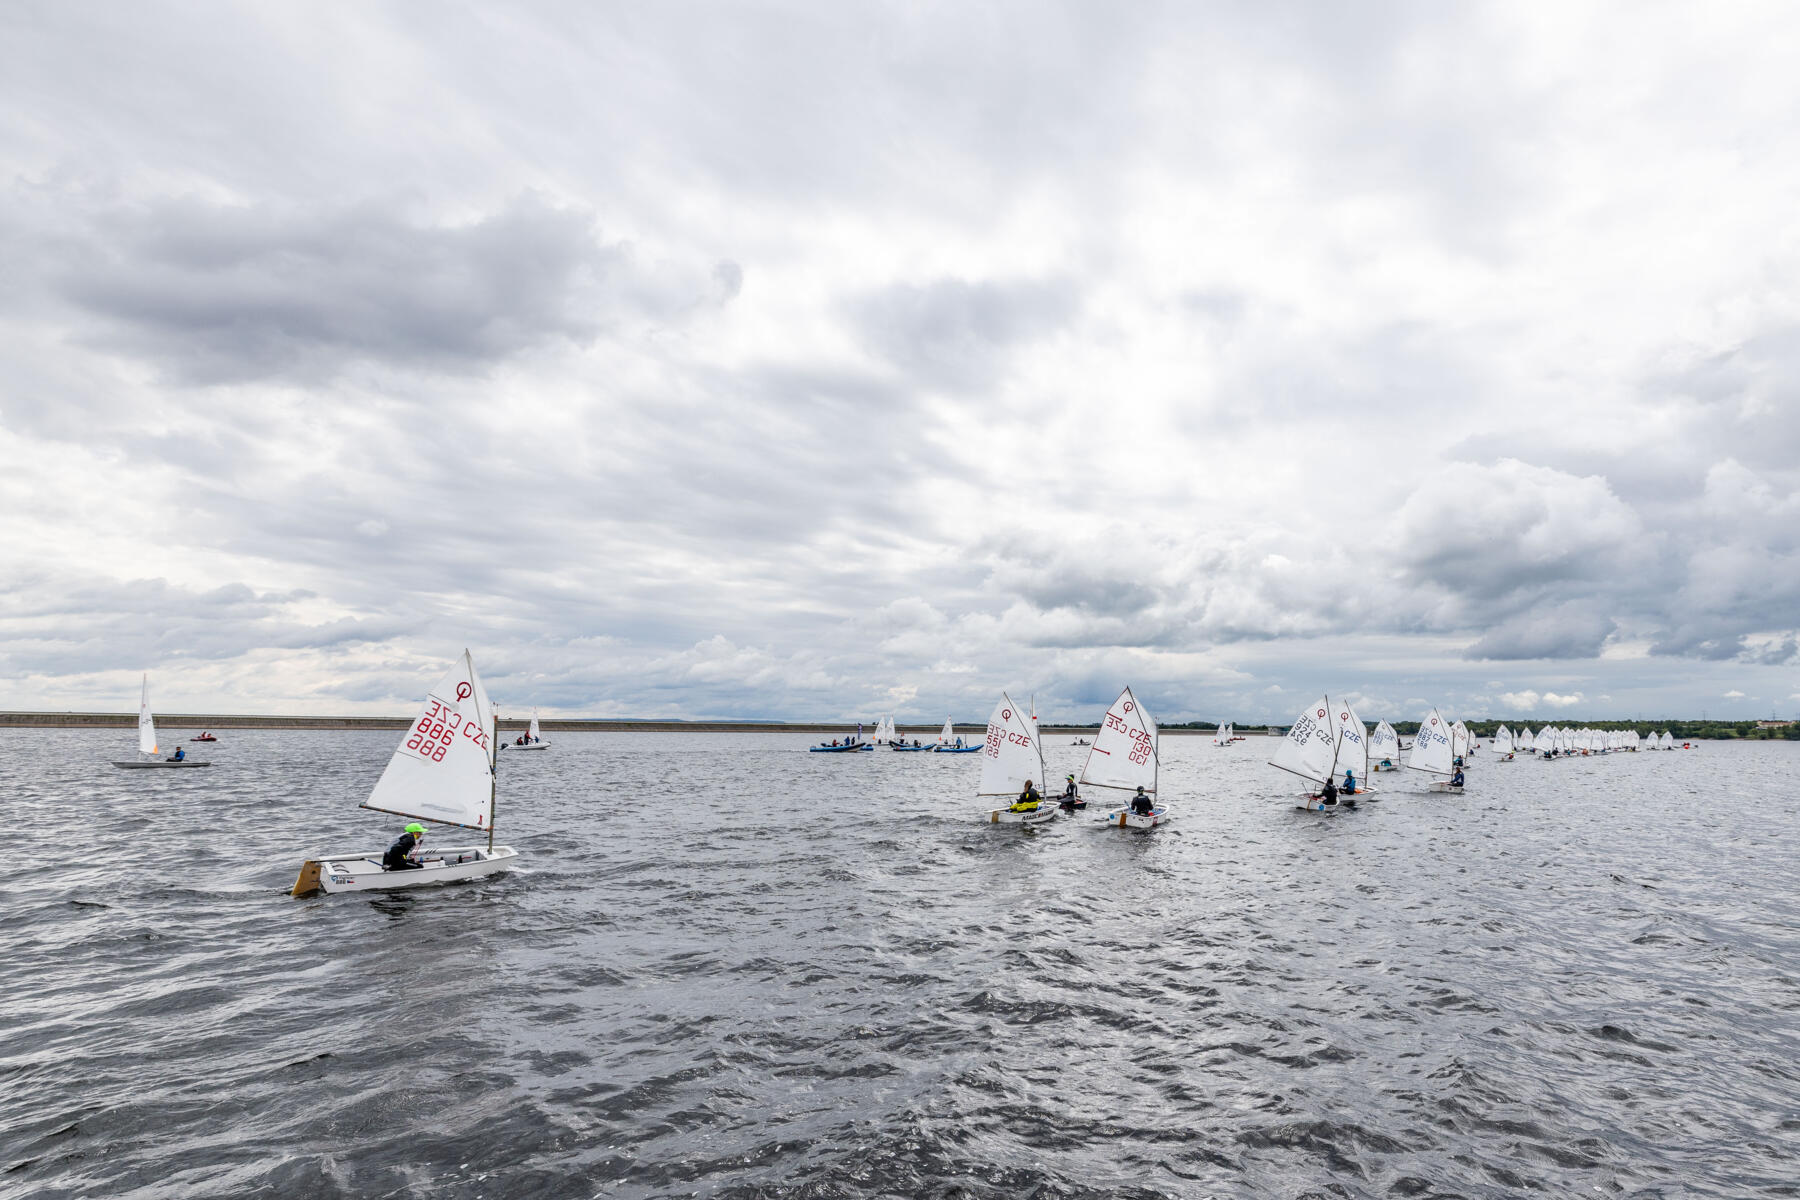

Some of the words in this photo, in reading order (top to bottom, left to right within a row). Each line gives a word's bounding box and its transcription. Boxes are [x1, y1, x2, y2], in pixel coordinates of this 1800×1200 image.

[417, 718, 454, 746] 886
[1129, 728, 1152, 744] CZE
[1295, 722, 1311, 738] 924
[1344, 730, 1360, 743] CZE
[986, 734, 1001, 748] 551
[1008, 732, 1031, 747] CZE
[1316, 730, 1334, 746] CZE
[1433, 733, 1448, 744] CZE
[1133, 742, 1151, 755] 130
